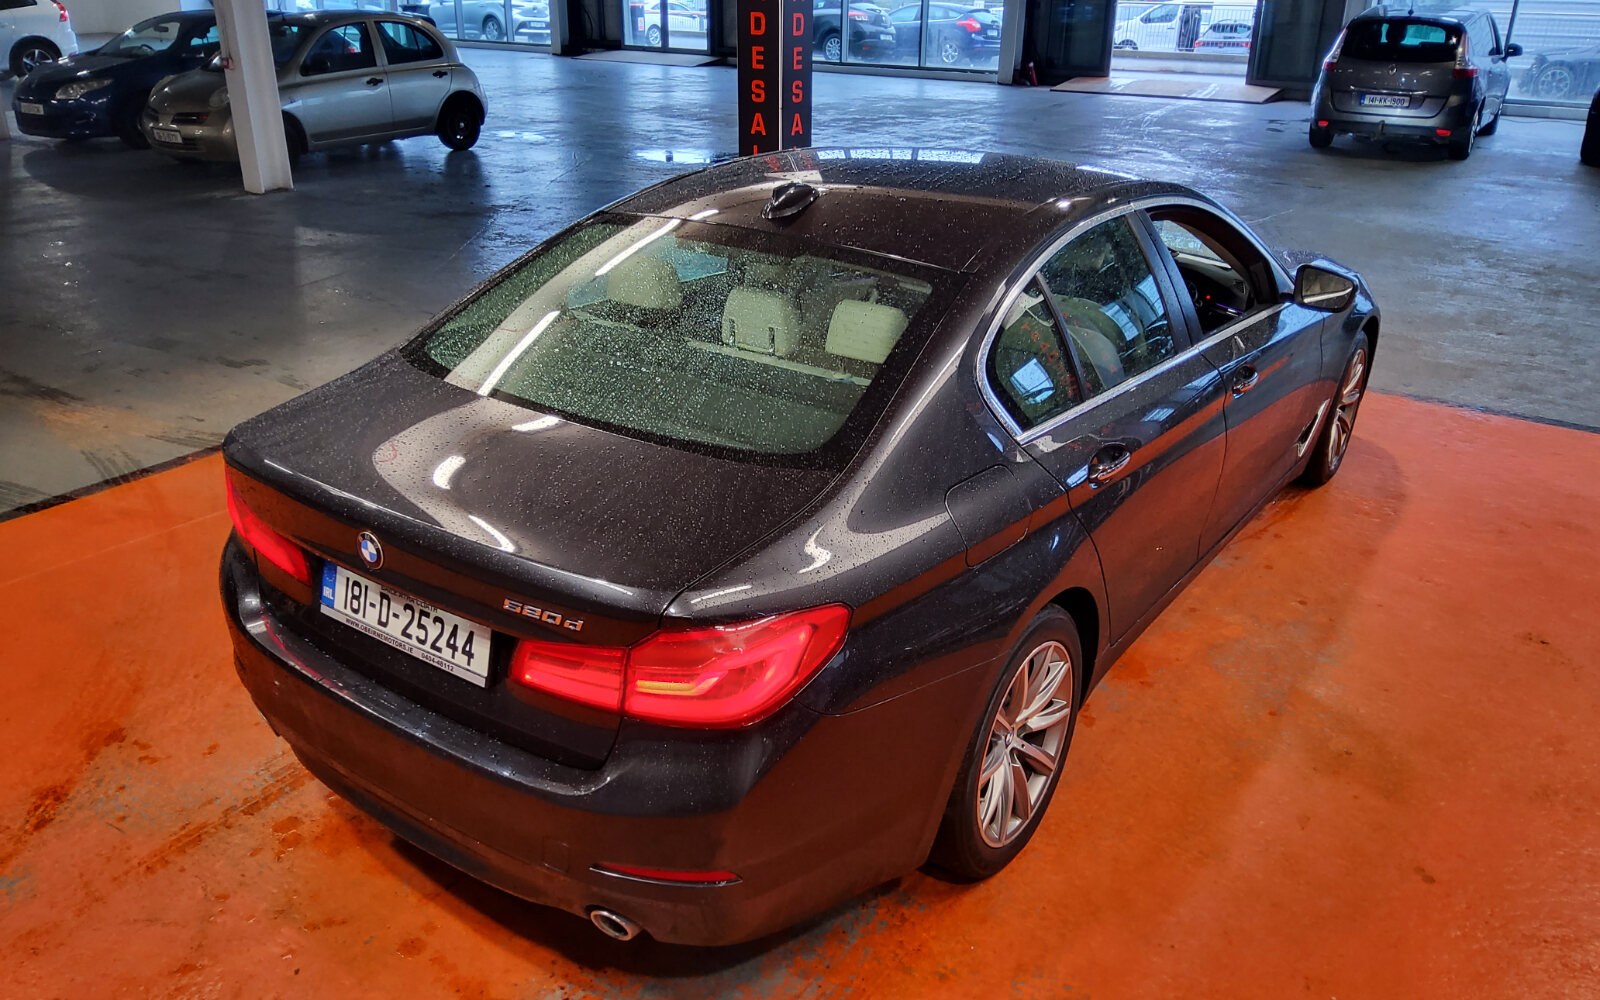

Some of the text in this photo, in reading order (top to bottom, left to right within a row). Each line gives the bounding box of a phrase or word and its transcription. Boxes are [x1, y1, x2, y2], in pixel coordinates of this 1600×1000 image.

[1368, 96, 1405, 106] 141-KK-1900
[323, 586, 334, 600] IRL
[343, 577, 475, 667] 181-D-25244
